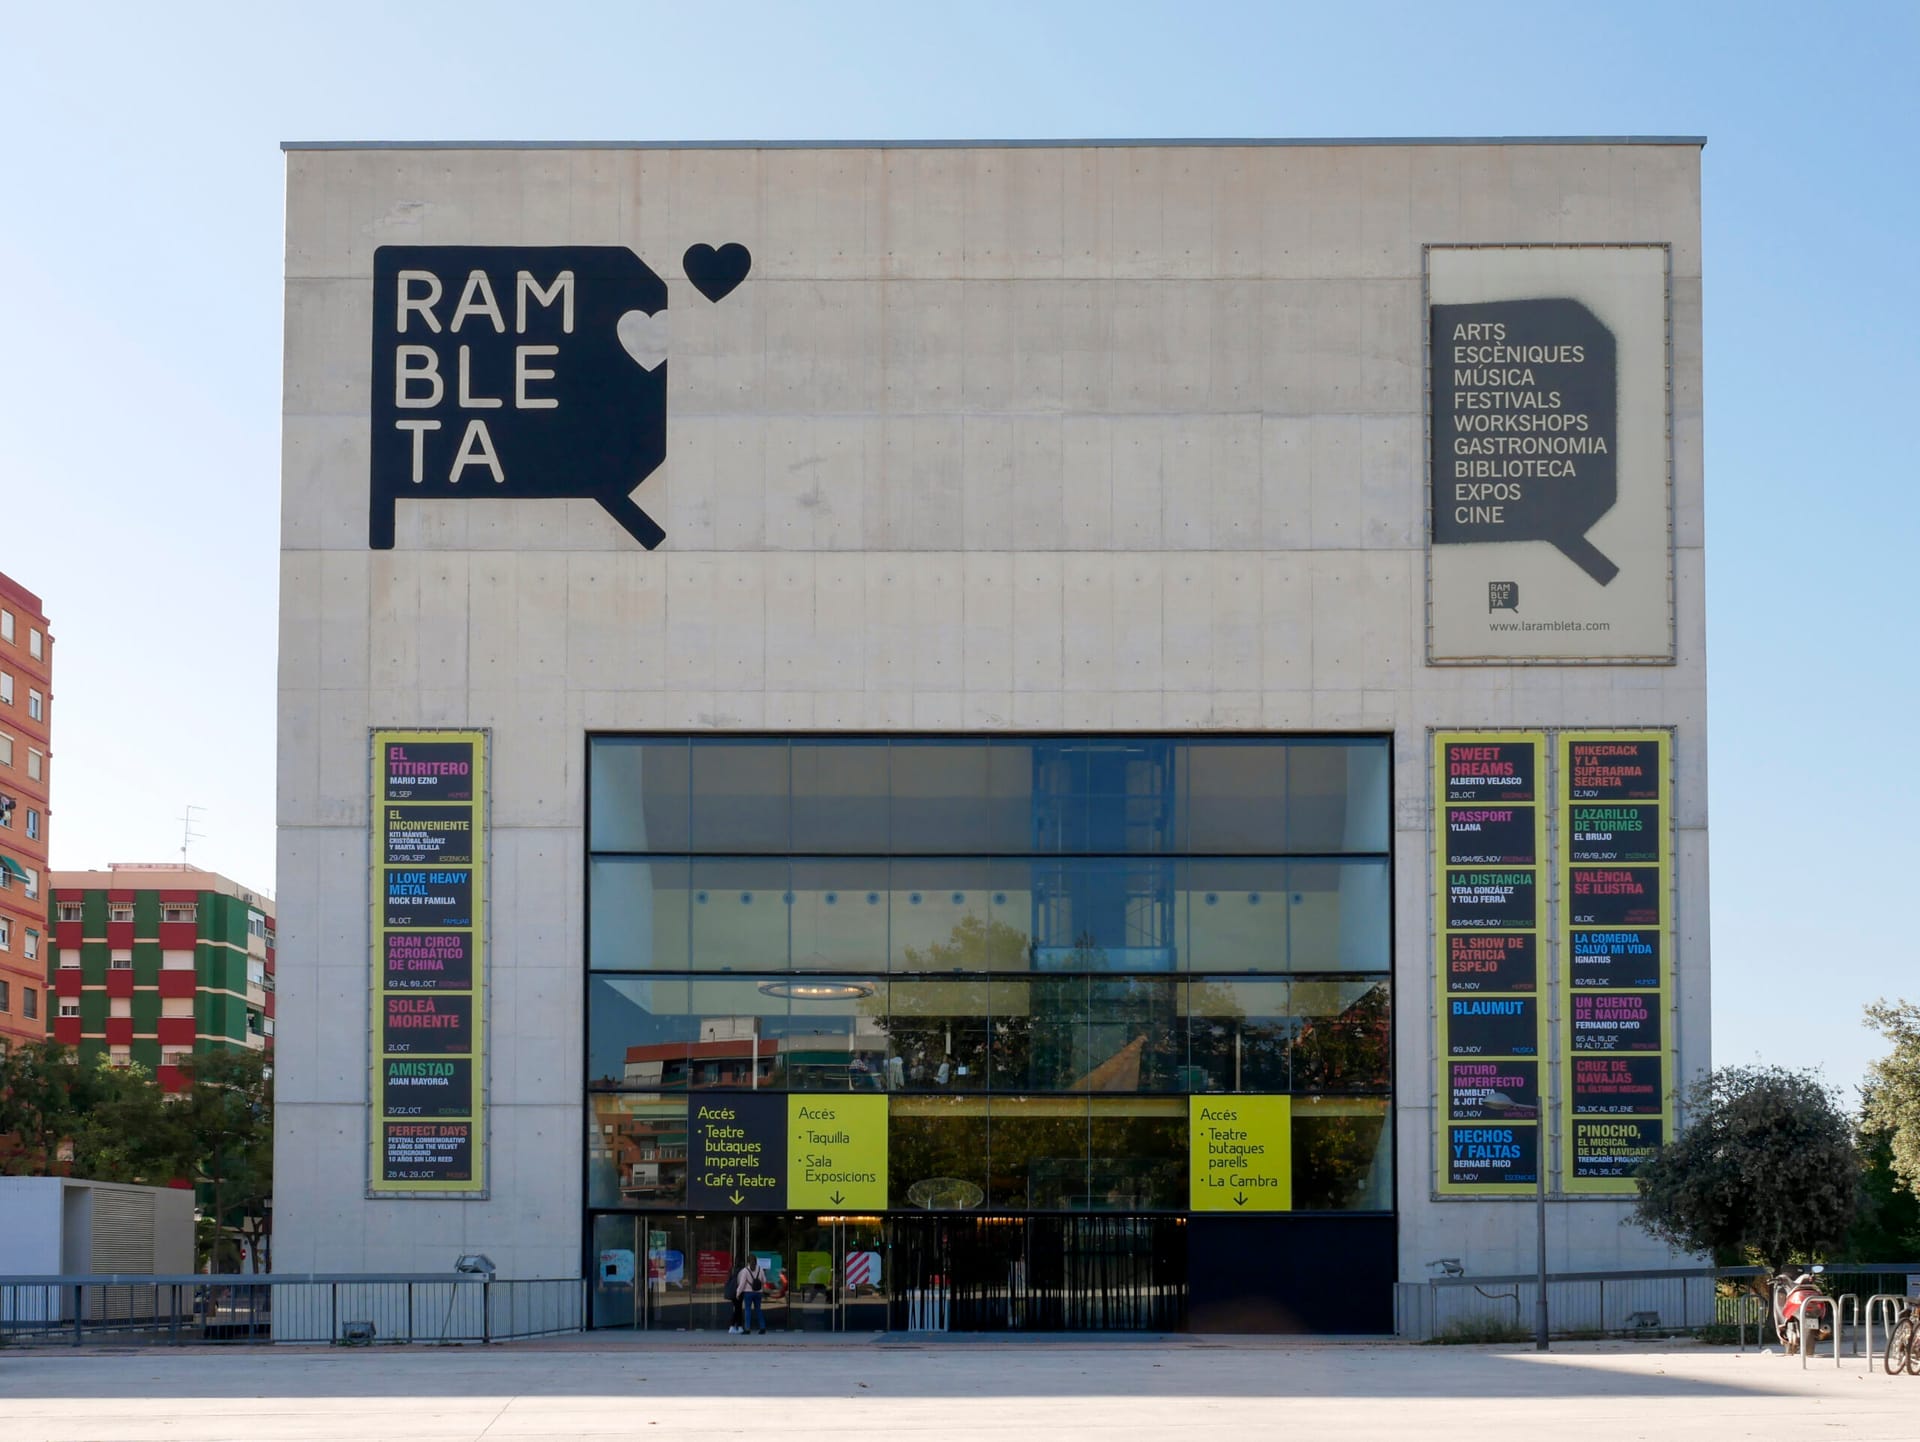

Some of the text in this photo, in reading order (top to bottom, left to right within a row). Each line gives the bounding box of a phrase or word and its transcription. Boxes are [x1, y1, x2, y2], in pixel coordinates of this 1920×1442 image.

[398, 270, 574, 334] RAM
[1453, 323, 1506, 340] ARTS
[1454, 341, 1584, 364] ESCÈNIQUES
[395, 344, 560, 408] BLE
[1454, 364, 1536, 386] MÚSICA
[1454, 391, 1562, 410] FESTIVALS
[1454, 414, 1588, 432] WORKSHOPS
[395, 420, 504, 484] TA
[1454, 437, 1608, 455] GASTRONOMIA
[1455, 460, 1576, 478] BIBLIOTECA
[1455, 483, 1522, 500] EXPOS
[1455, 506, 1504, 524] CINE
[1489, 620, 1610, 632] www.larambleta.com
[390, 747, 407, 760] EL
[1450, 748, 1500, 760] SWEET
[1574, 746, 1638, 755] MIKECRACK
[1575, 756, 1598, 766] Y LA
[390, 762, 469, 775] TITIRITERO
[1450, 762, 1514, 776] DREAMS
[1574, 766, 1642, 776] SUPERARMA
[1574, 777, 1622, 786] SECRETA
[390, 810, 402, 819] EL
[1451, 811, 1512, 822] PASSPORT
[1574, 809, 1638, 820] LAZARILLO
[390, 821, 469, 830] INCONVENIENTE
[1575, 821, 1643, 831] DE TORMES
[389, 873, 468, 884] I LOVE HEAVY
[1451, 874, 1533, 885] LA DISTANCIA
[390, 885, 428, 895] METAL
[1474, 885, 1514, 894] GONZÁLEZ
[1575, 883, 1644, 894] SE ILUSTRA
[389, 936, 460, 947] GRAN CIRCO
[1452, 938, 1524, 948] EL SHOW DE
[1575, 934, 1639, 943] LA COMEDIA
[389, 947, 463, 959] ACROBÁTICO
[1452, 950, 1505, 960] PATRICIA
[1575, 944, 1652, 954] SALVÓ MI VIDA
[389, 960, 444, 970] DE CHINA
[1452, 961, 1497, 972] ESPEJO
[388, 997, 435, 1013] SOLEÁ
[1453, 1002, 1524, 1015] BLAUMUT
[1576, 997, 1642, 1008] UN CUENTO
[1576, 1009, 1648, 1020] DE NAVIDAD
[388, 1015, 460, 1028] MORENTE
[388, 1063, 455, 1076] AMISTAD
[1453, 1065, 1497, 1075] FUTURO
[1577, 1061, 1627, 1071] CRUZ DE
[1454, 1077, 1524, 1087] IMPERFECTO
[1577, 1073, 1632, 1083] NAVAJAS
[388, 1126, 467, 1136] PERFECT DAYS
[706, 1124, 744, 1138] Teatre
[1208, 1128, 1247, 1140] Teatre
[1454, 1130, 1513, 1143] HECHOS
[1578, 1125, 1641, 1138] PINOCHO,
[806, 1130, 850, 1145] Taquilla
[705, 1139, 761, 1154] butaques
[1209, 1142, 1264, 1156] butaques
[1454, 1145, 1521, 1158] Y FALTAS
[705, 1154, 759, 1169] imparells
[806, 1154, 832, 1167] Sala
[1209, 1156, 1248, 1170] parells
[705, 1172, 776, 1187] Café Teatre
[805, 1169, 876, 1184] Exposicions
[1209, 1174, 1278, 1187] La Cambra
